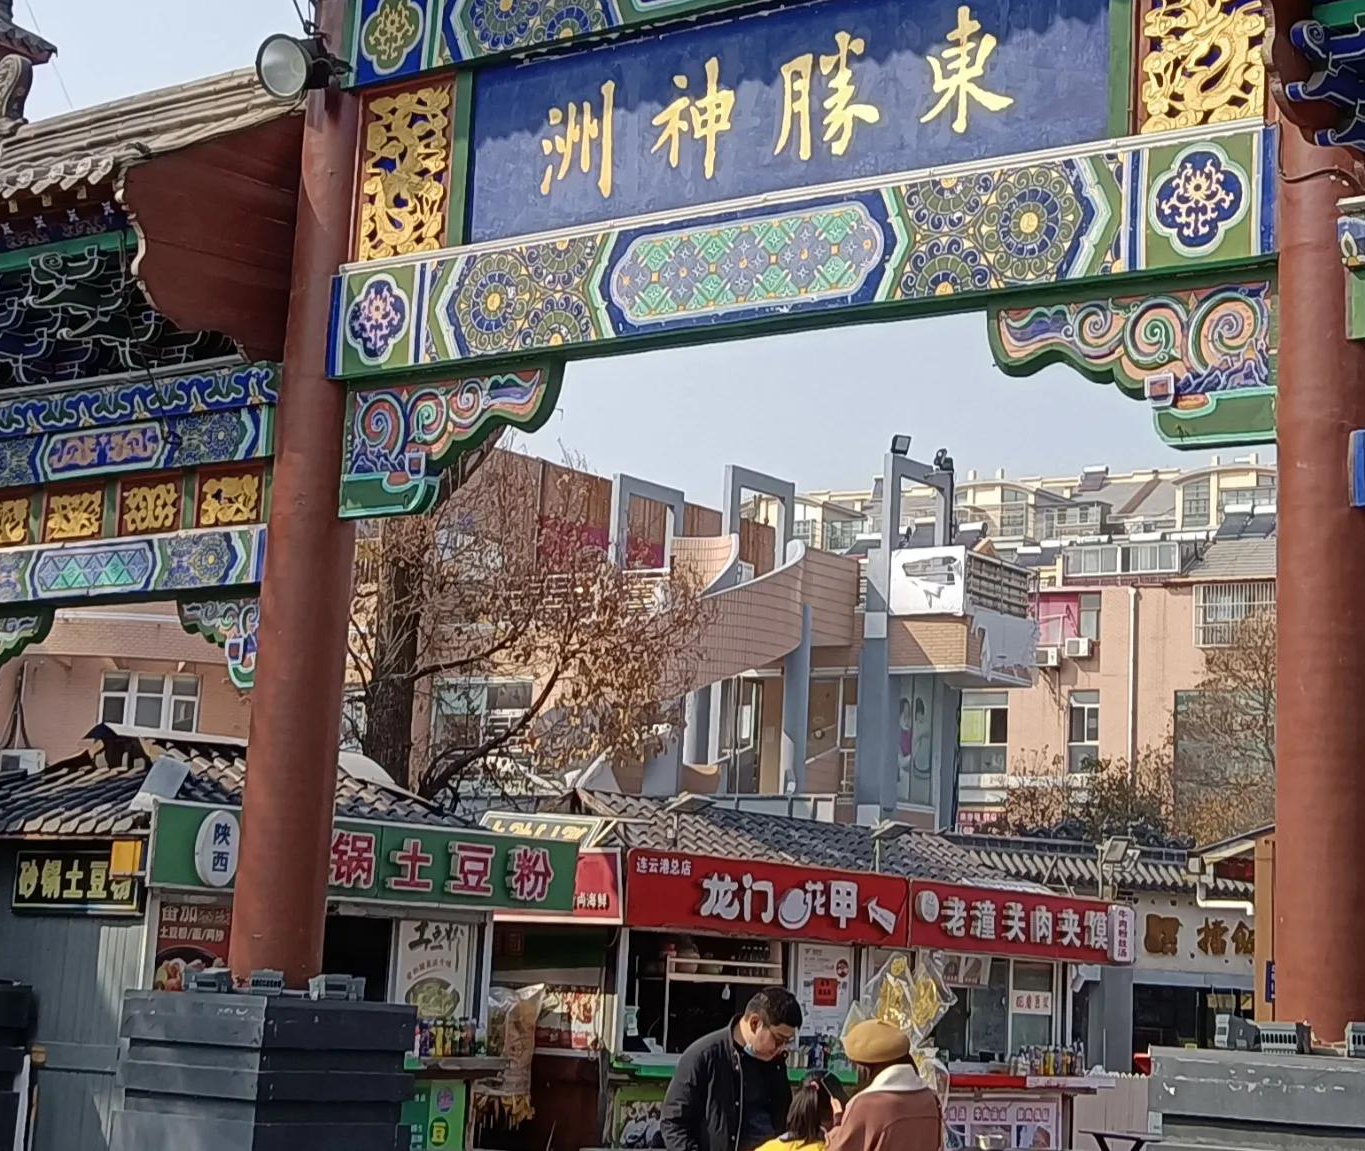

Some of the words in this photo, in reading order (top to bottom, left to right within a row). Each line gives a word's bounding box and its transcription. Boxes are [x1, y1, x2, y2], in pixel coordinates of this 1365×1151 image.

[212, 823, 231, 873] 陕西
[636, 857, 692, 877] 连云港总店
[700, 873, 859, 929] 龙门花甲
[941, 896, 1108, 950] 老潼关肉夹馍
